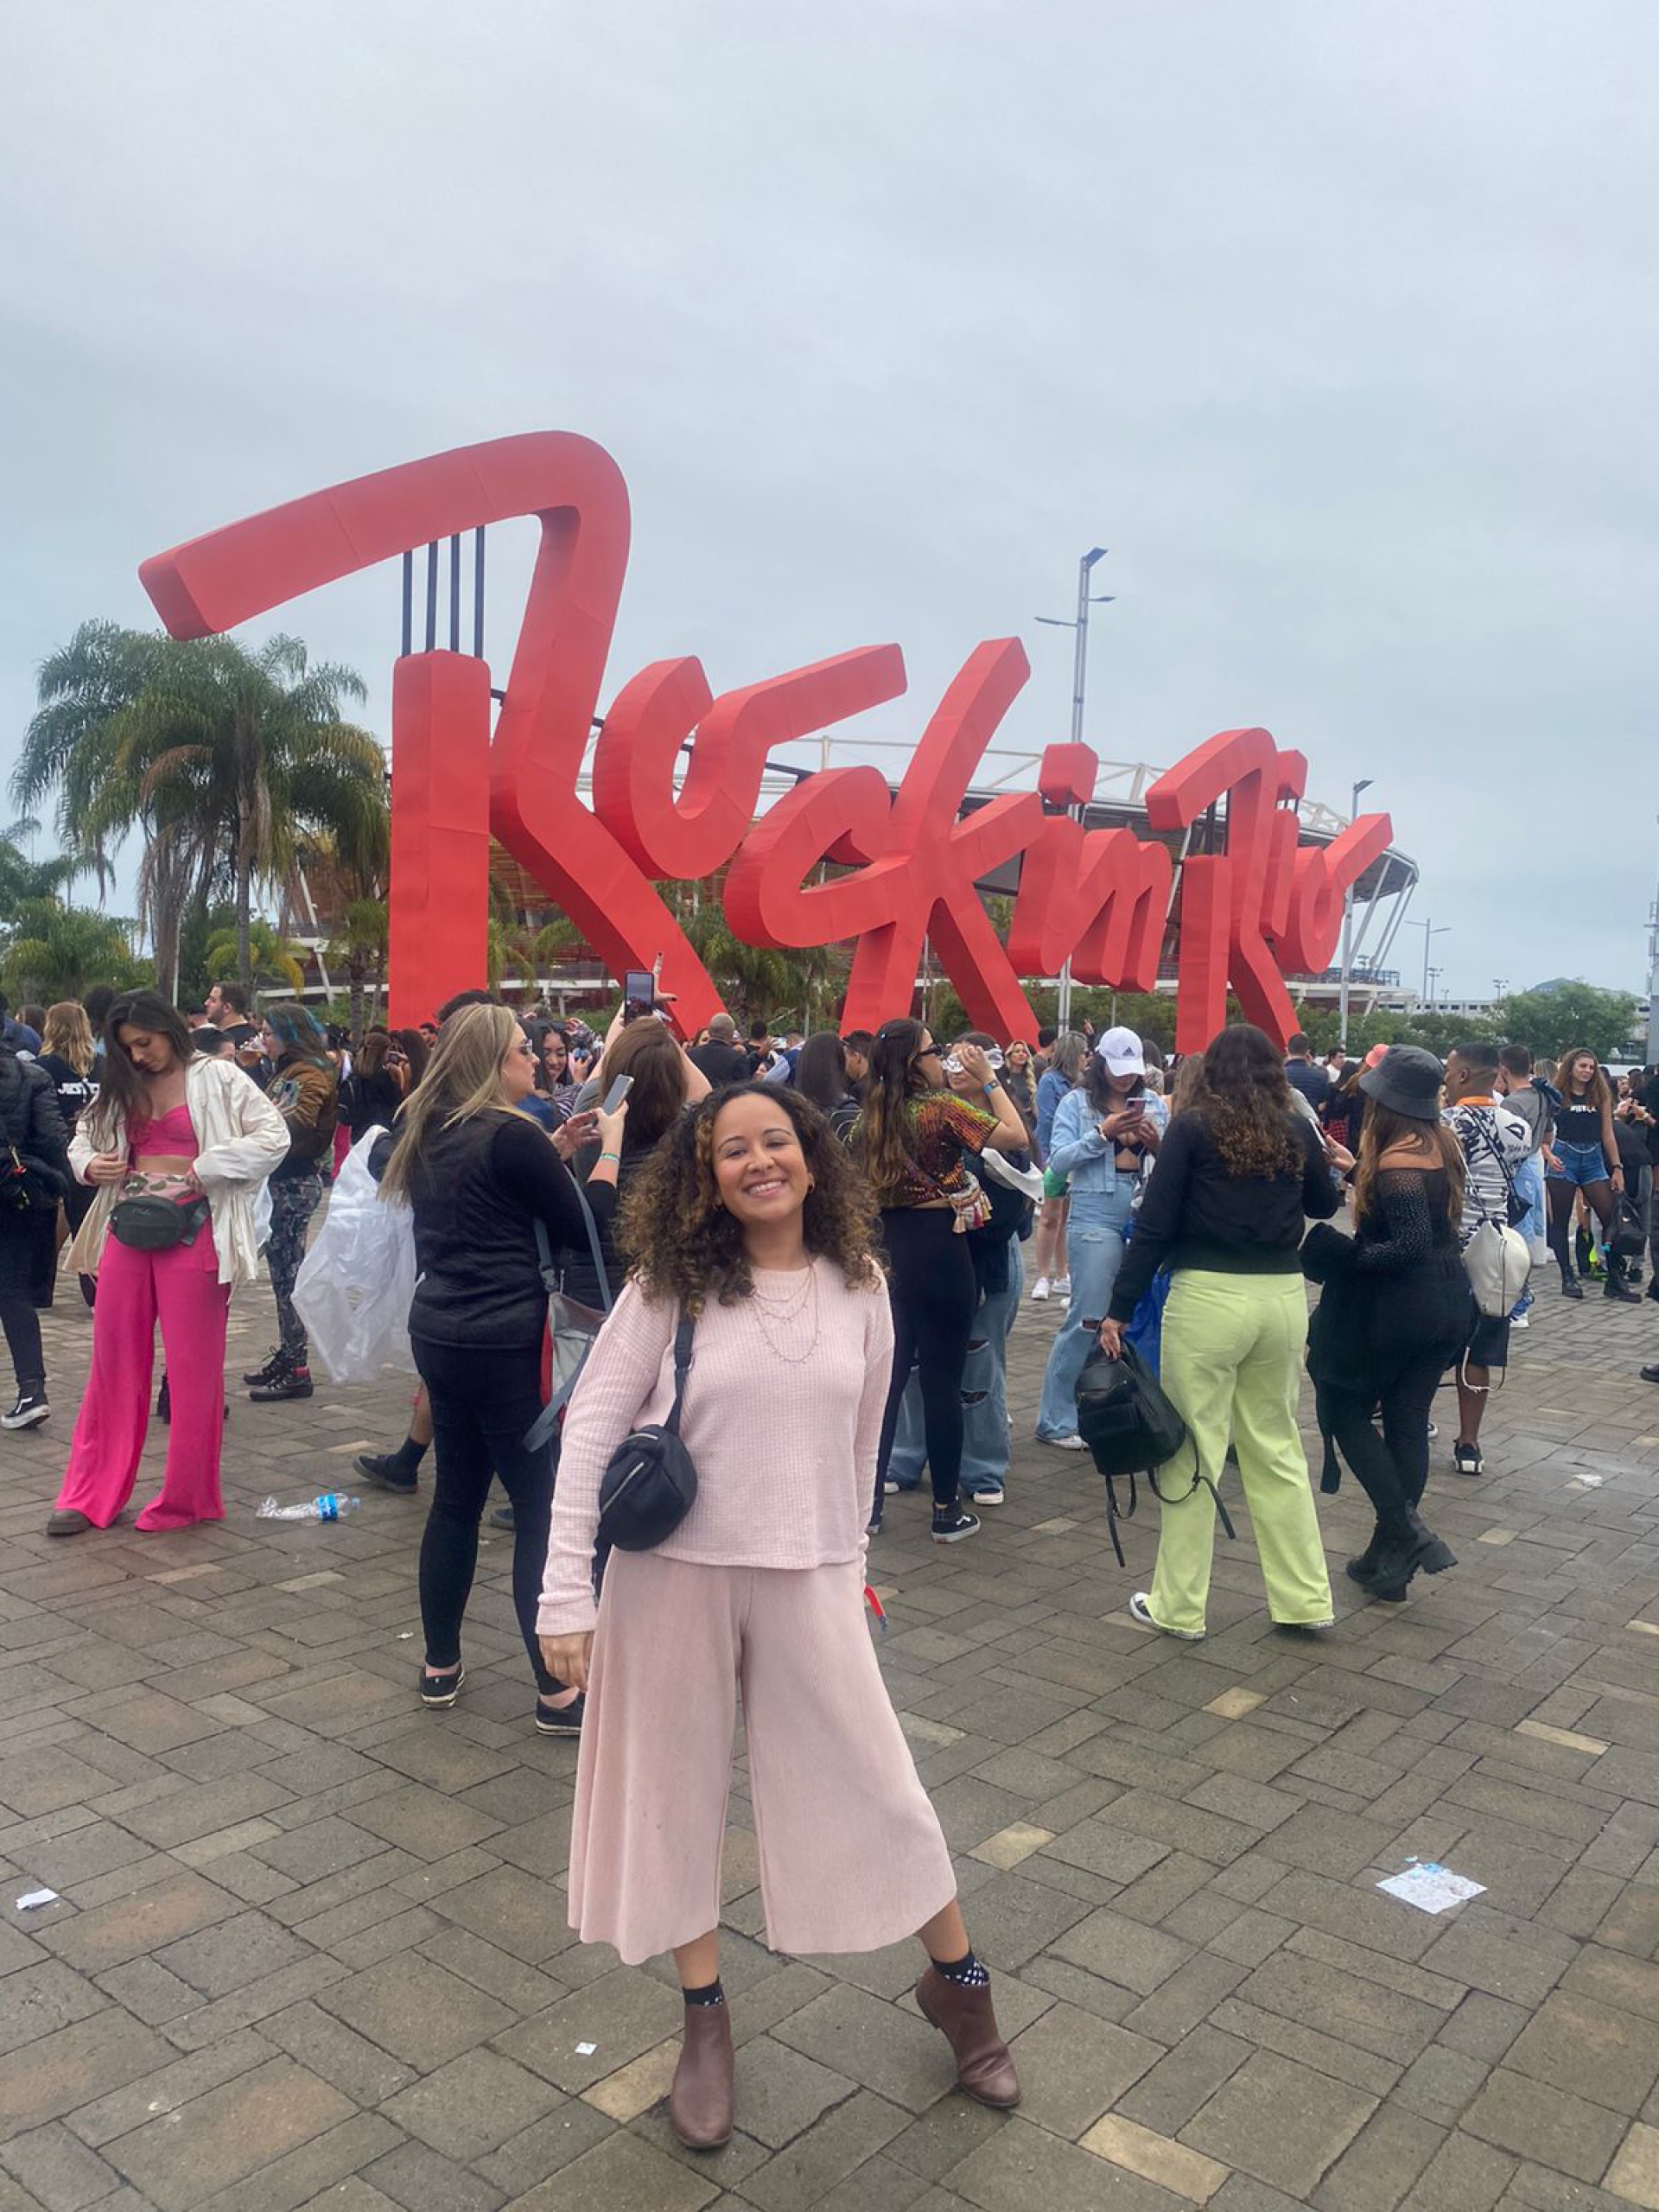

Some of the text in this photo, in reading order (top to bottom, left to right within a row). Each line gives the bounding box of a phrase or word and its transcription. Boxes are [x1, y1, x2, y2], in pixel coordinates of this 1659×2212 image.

[138, 429, 1394, 1057] Rock in Rio
